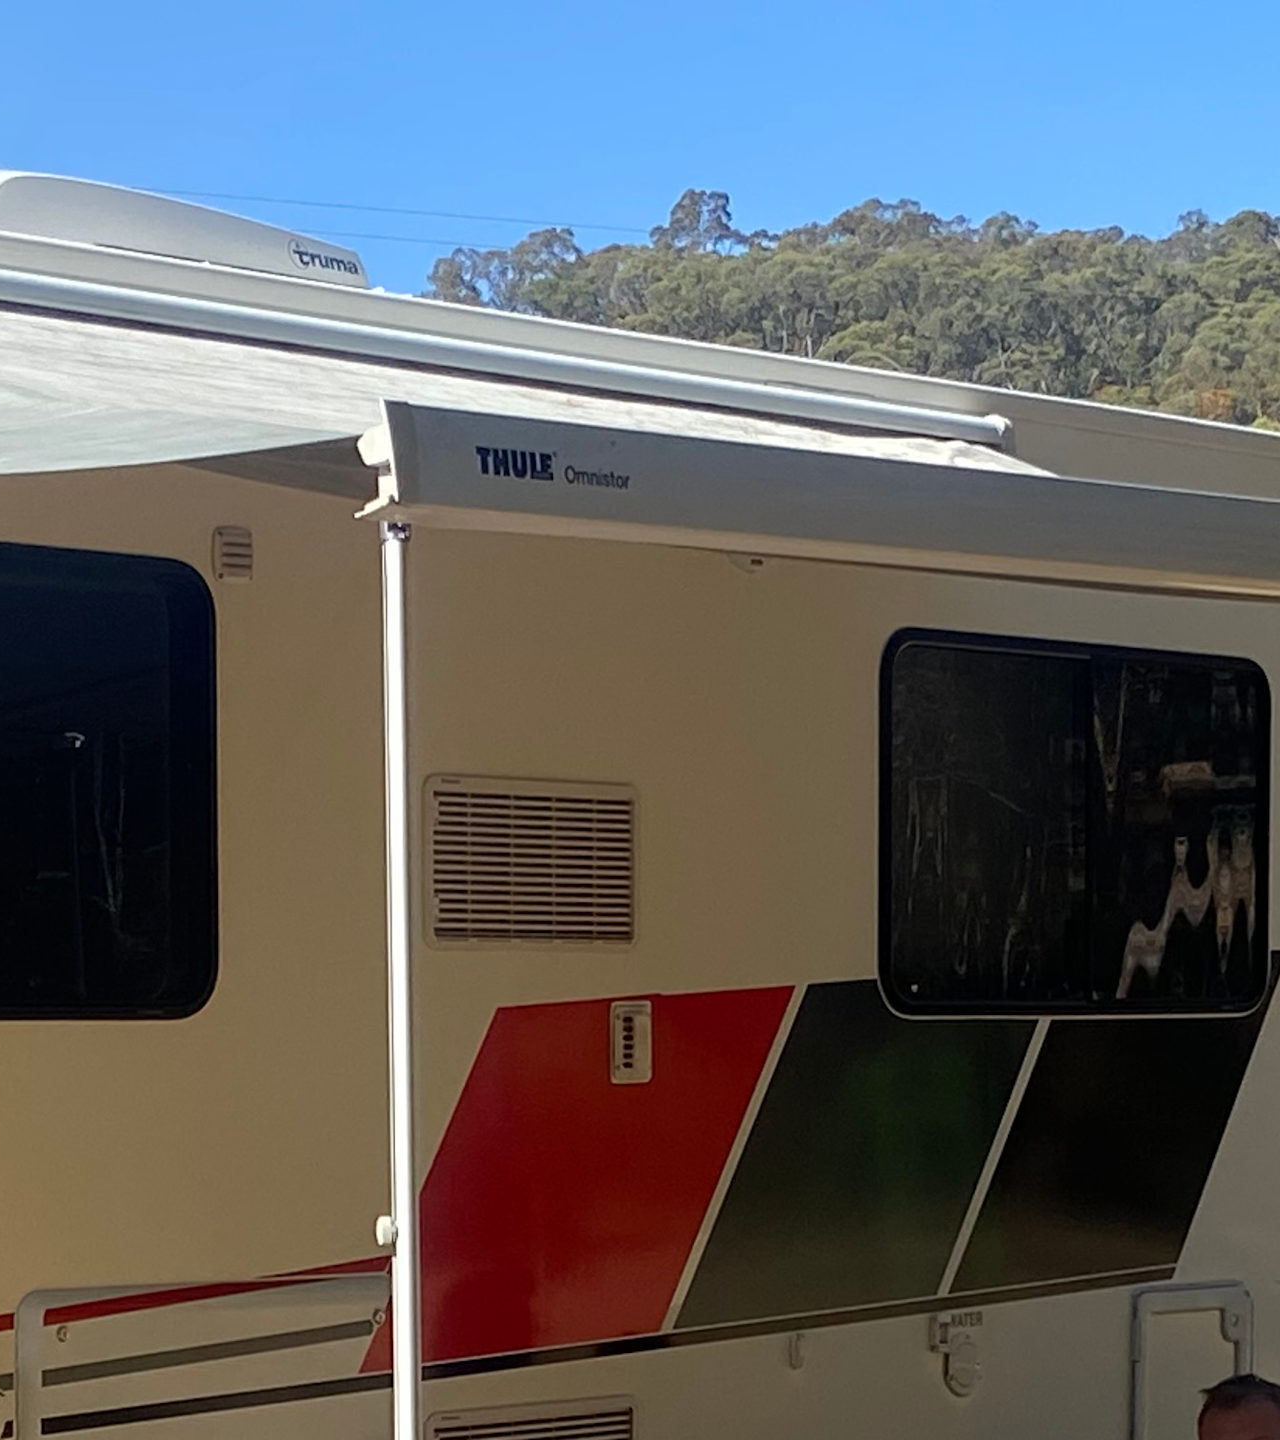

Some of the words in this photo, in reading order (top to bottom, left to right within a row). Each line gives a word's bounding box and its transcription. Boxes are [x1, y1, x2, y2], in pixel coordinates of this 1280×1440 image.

[291, 243, 360, 275] truma
[475, 446, 554, 481] THULE
[564, 465, 630, 489] Omnistor
